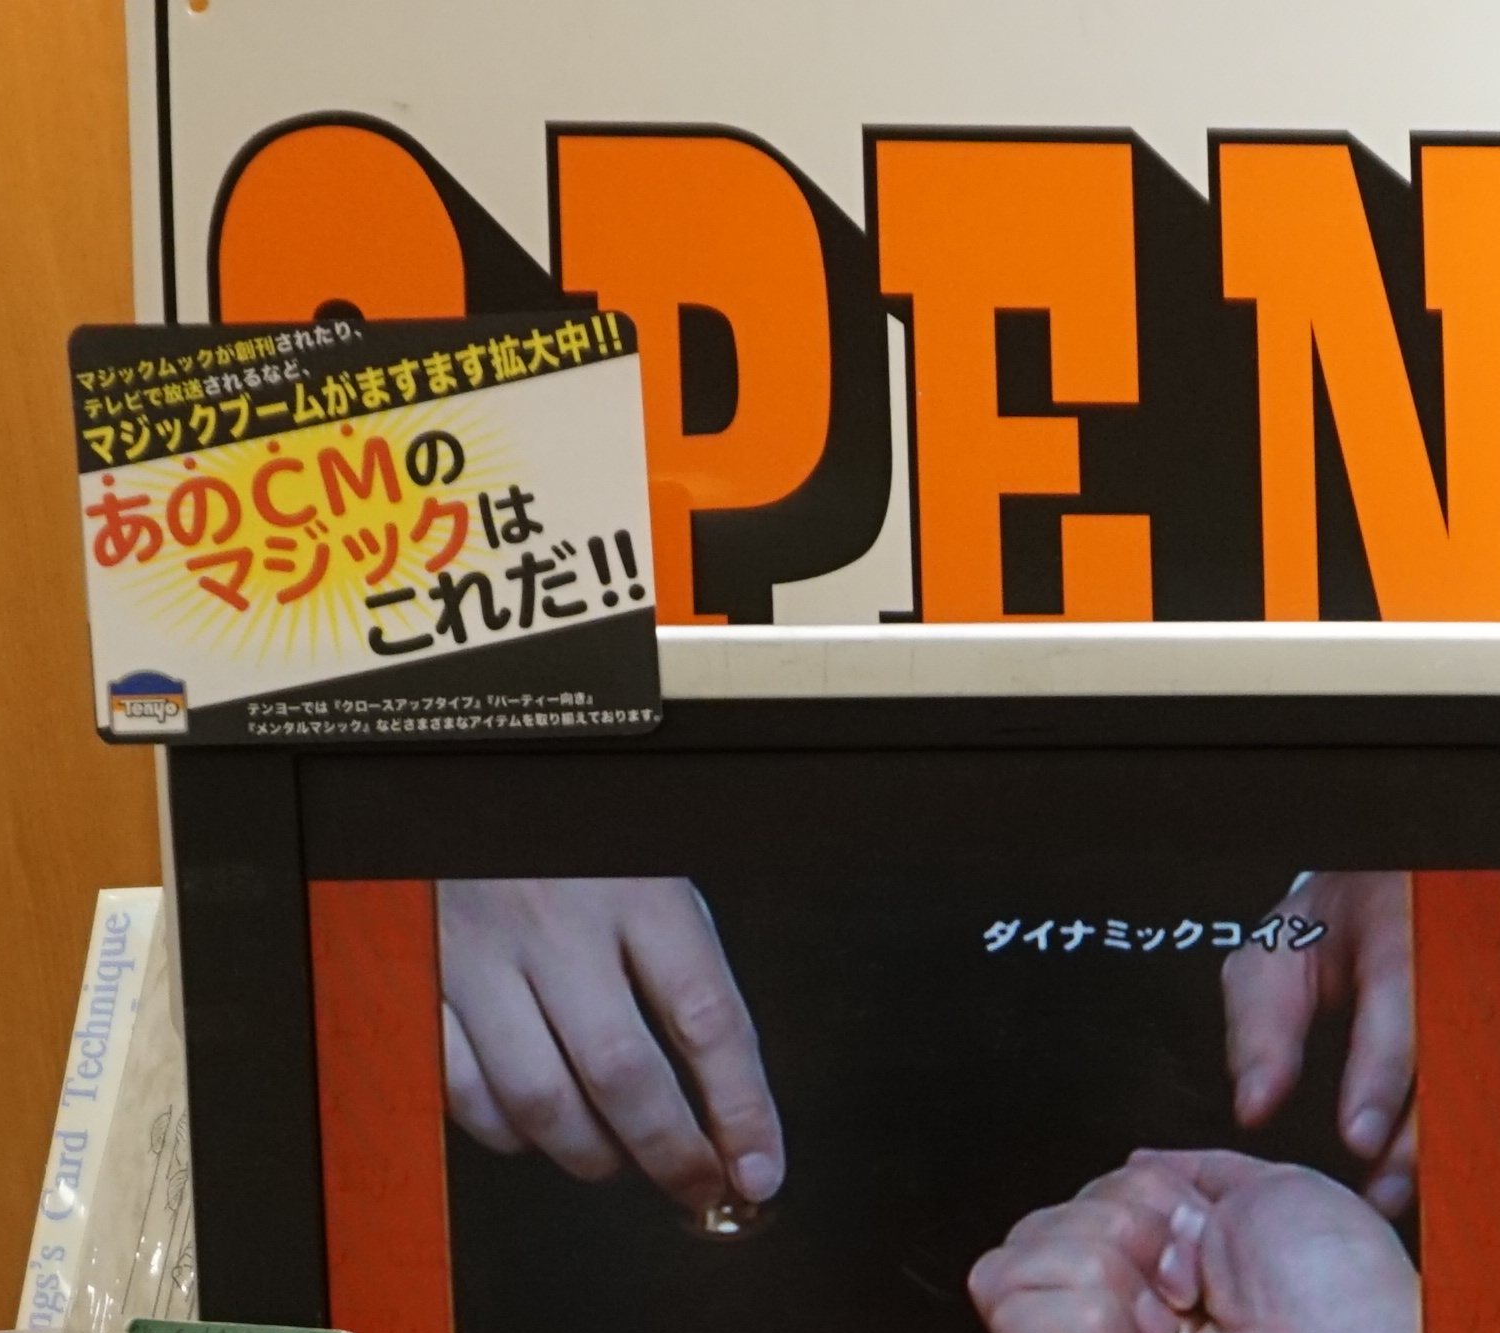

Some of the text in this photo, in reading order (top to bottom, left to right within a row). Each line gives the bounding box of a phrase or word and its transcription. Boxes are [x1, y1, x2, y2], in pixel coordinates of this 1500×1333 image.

[86, 428, 465, 567] あのCMの
[186, 485, 544, 612] マジックは
[116, 698, 179, 726] Tenyo
[983, 915, 1327, 953] ダイナミックコイン
[40, 911, 136, 1224] Card Technique
